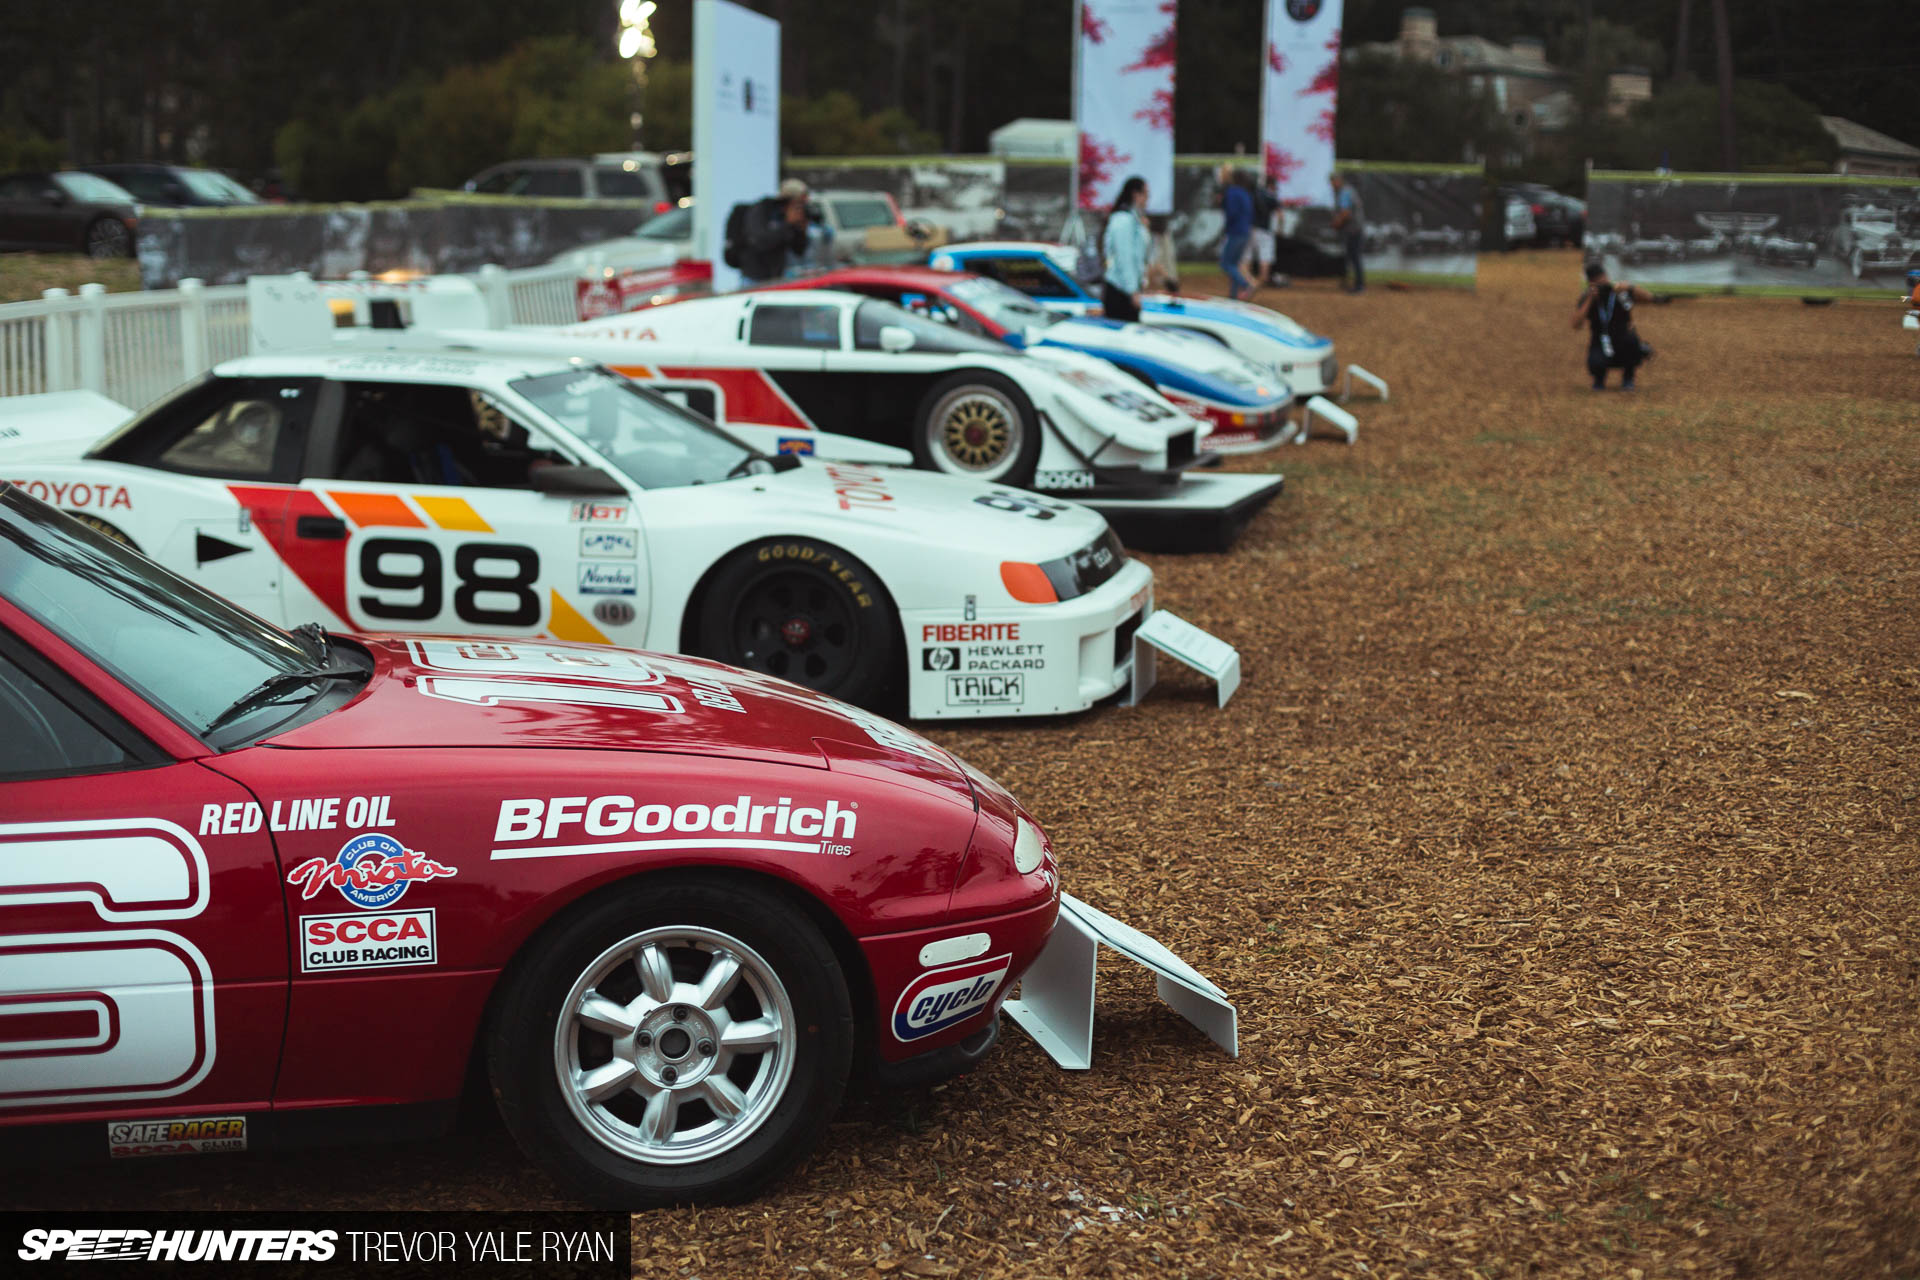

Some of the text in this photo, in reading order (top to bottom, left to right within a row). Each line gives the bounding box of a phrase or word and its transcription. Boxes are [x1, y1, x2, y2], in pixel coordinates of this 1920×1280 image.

[1034, 472, 1095, 489] BOSCH
[591, 506, 627, 519] GT
[585, 535, 632, 548] CAMEL
[358, 538, 541, 626] 98
[758, 544, 872, 609] GOODYEAR
[922, 623, 1020, 642] FIBERITE
[968, 645, 1044, 656] HEWLETT
[968, 659, 1045, 670] PACKARD
[951, 676, 1019, 697] TRICK
[199, 796, 396, 835] RED LINE OIL
[494, 795, 858, 841] BFGoodrich
[345, 839, 397, 862] CLUB OF
[819, 840, 852, 856] Tires
[350, 882, 402, 903] AMERICA
[308, 917, 427, 946] SCCA
[309, 945, 430, 965] CLUB RACING
[911, 976, 995, 1024] cyclo
[112, 1120, 244, 1144] SAFERACER
